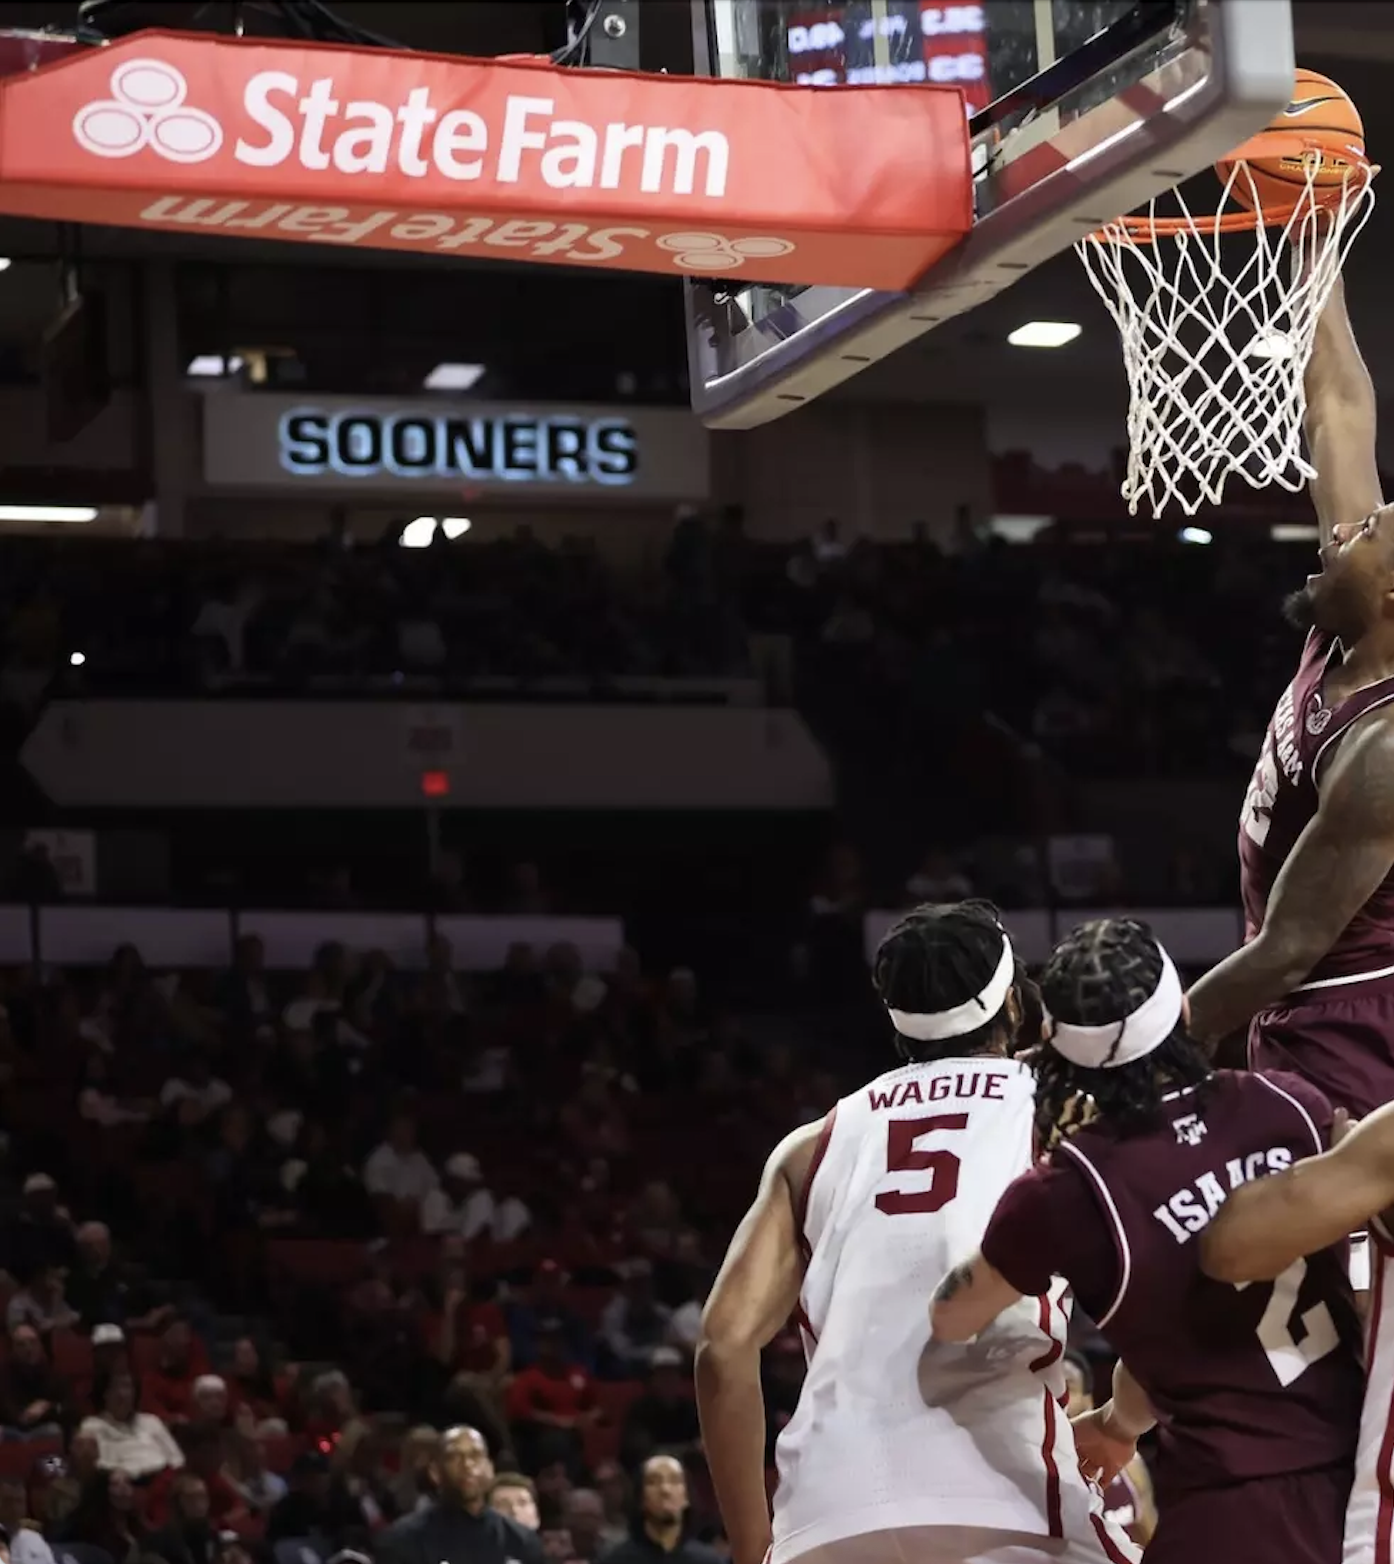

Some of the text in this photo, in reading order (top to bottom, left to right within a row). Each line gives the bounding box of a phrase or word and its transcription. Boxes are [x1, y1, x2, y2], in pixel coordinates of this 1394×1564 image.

[282, 410, 639, 483] SOONERS
[868, 1072, 1009, 1112] WAGUE
[875, 1112, 970, 1217] 5
[1153, 1146, 1295, 1245] ISAACS
[1233, 1255, 1341, 1388] 2
